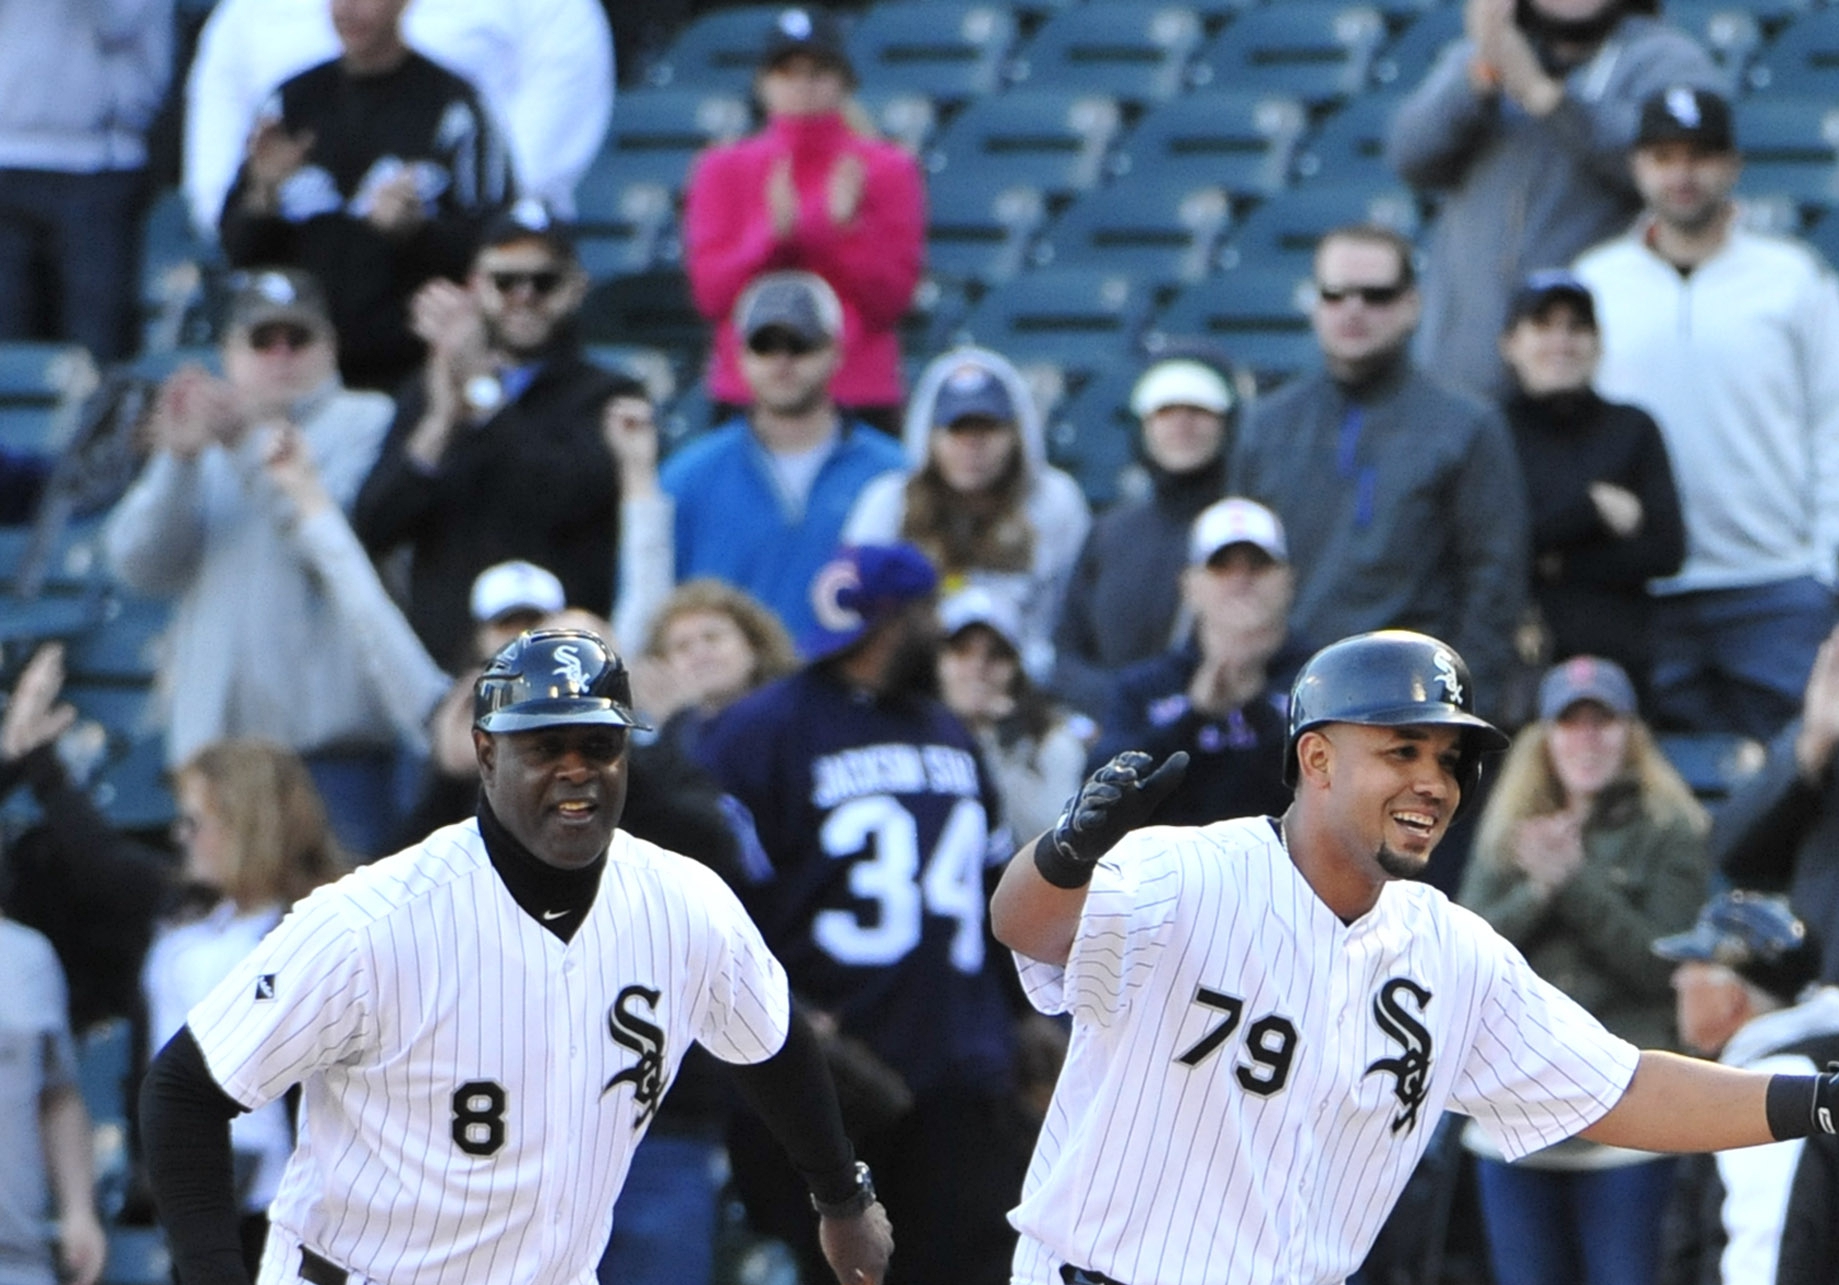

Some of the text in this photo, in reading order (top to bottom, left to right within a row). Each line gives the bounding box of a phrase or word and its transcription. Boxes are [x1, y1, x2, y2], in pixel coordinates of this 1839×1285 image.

[812, 559, 865, 633] C
[812, 794, 988, 976] 34
[1173, 983, 1300, 1101] 79
[451, 1078, 508, 1159] 8
